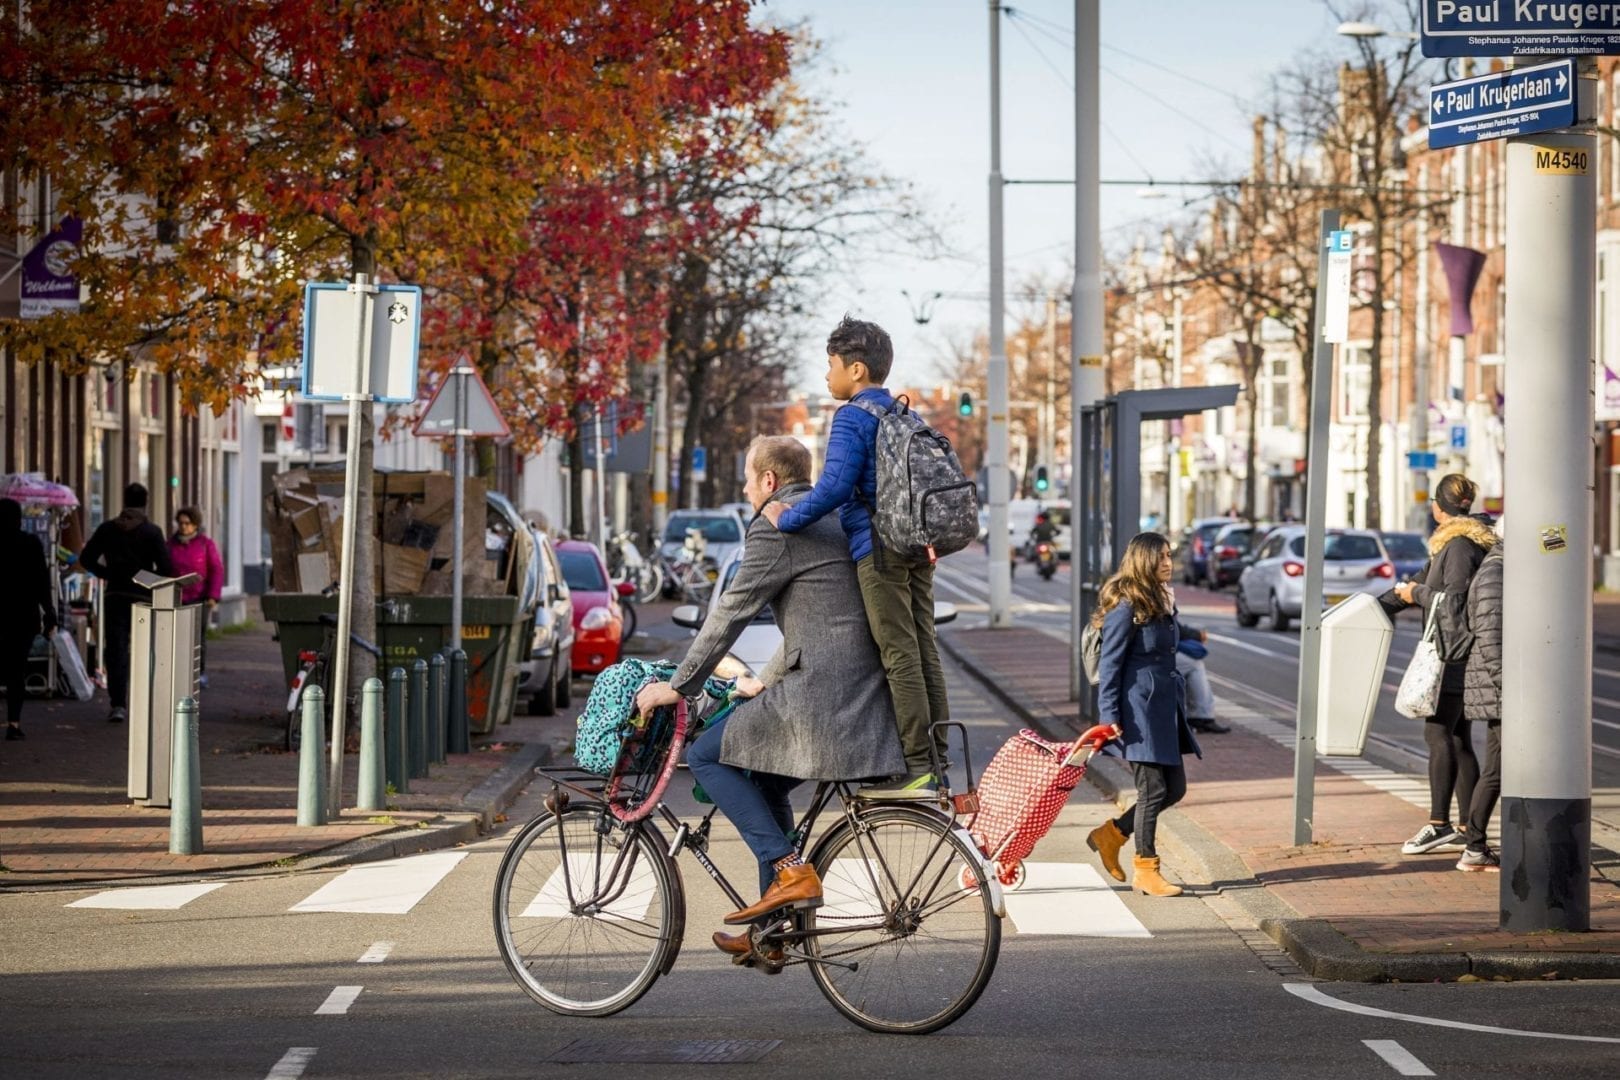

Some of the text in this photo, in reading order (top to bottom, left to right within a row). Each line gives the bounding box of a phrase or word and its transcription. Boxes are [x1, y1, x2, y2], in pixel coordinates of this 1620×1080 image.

[1437, 0, 1499, 23] Paul
[1468, 36, 1511, 46] Stephanus
[1512, 36, 1551, 44] Johannes
[1552, 35, 1579, 43] Paulus
[1513, 46, 1605, 55] Zuidafrikaans staatsman
[1447, 76, 1552, 113] Paul Krugerlaan
[1537, 151, 1587, 170] M4540
[695, 850, 718, 878] UNION
